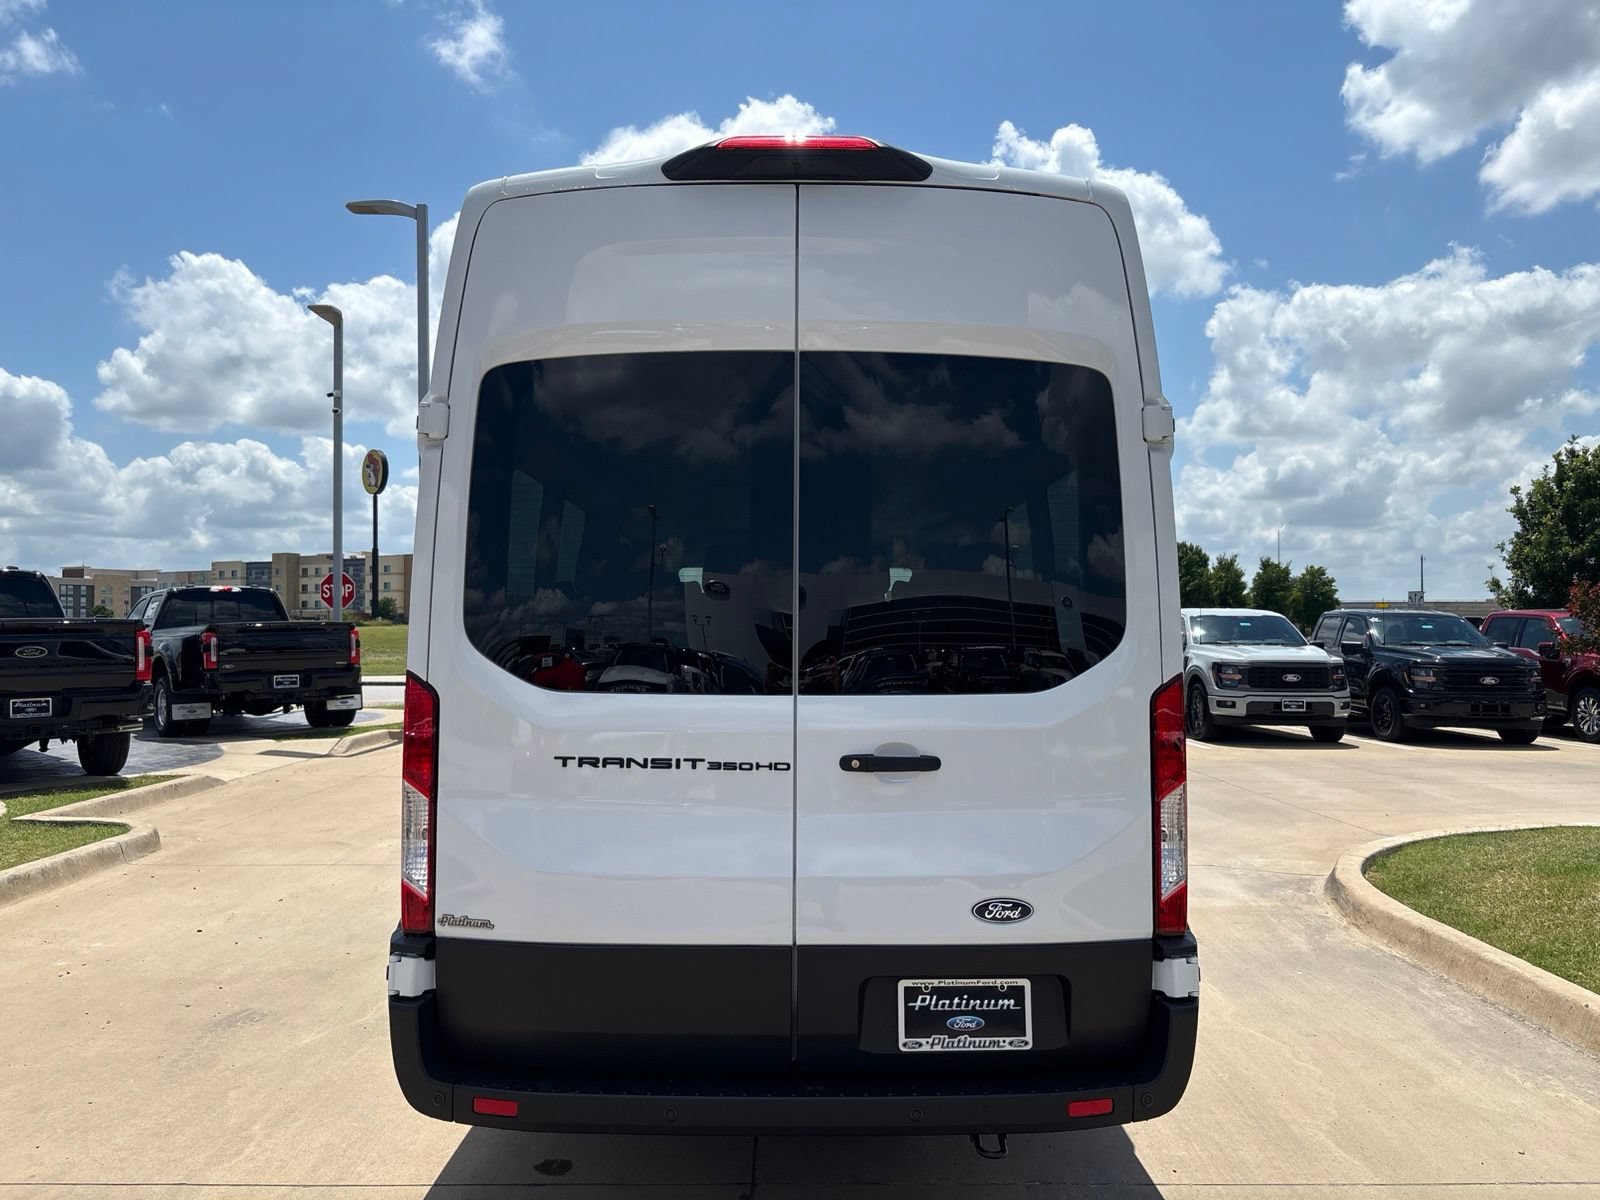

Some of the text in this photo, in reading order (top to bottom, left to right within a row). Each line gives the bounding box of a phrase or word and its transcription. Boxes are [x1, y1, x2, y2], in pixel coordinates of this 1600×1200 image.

[322, 584, 353, 598] SP
[985, 902, 1022, 918] Ford
[437, 914, 495, 929] Platinum
[907, 994, 1021, 1011] Platinum
[953, 1018, 977, 1028] Ford
[905, 1035, 1026, 1049] Ford Platinum Ford
